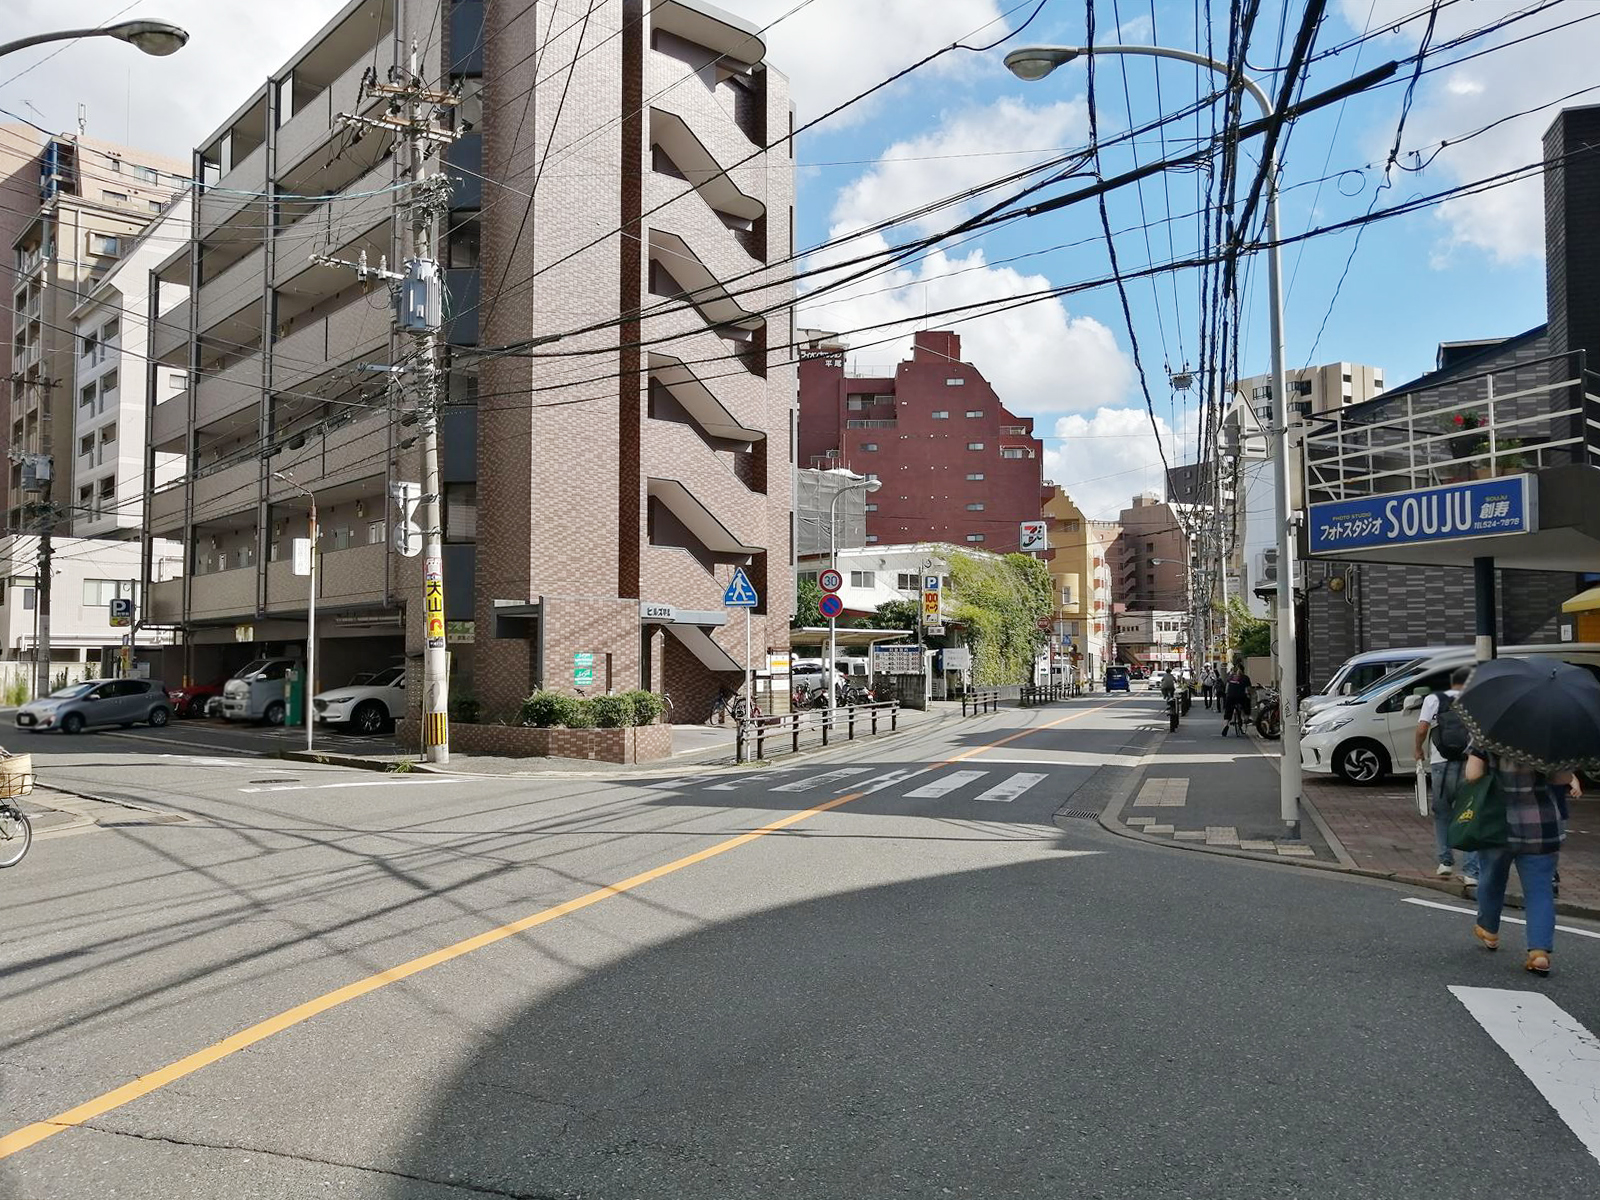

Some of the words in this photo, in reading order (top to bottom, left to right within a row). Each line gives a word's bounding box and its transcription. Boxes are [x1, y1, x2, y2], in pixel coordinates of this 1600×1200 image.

[1352, 511, 1372, 519] STUDIO
[1386, 490, 1471, 539] SOUJU
[1479, 501, 1510, 519] 創寿
[1320, 517, 1383, 541] フォトスタジオ
[824, 575, 838, 587] 30
[927, 576, 937, 588] P
[925, 593, 938, 603] 100
[112, 600, 127, 617] P
